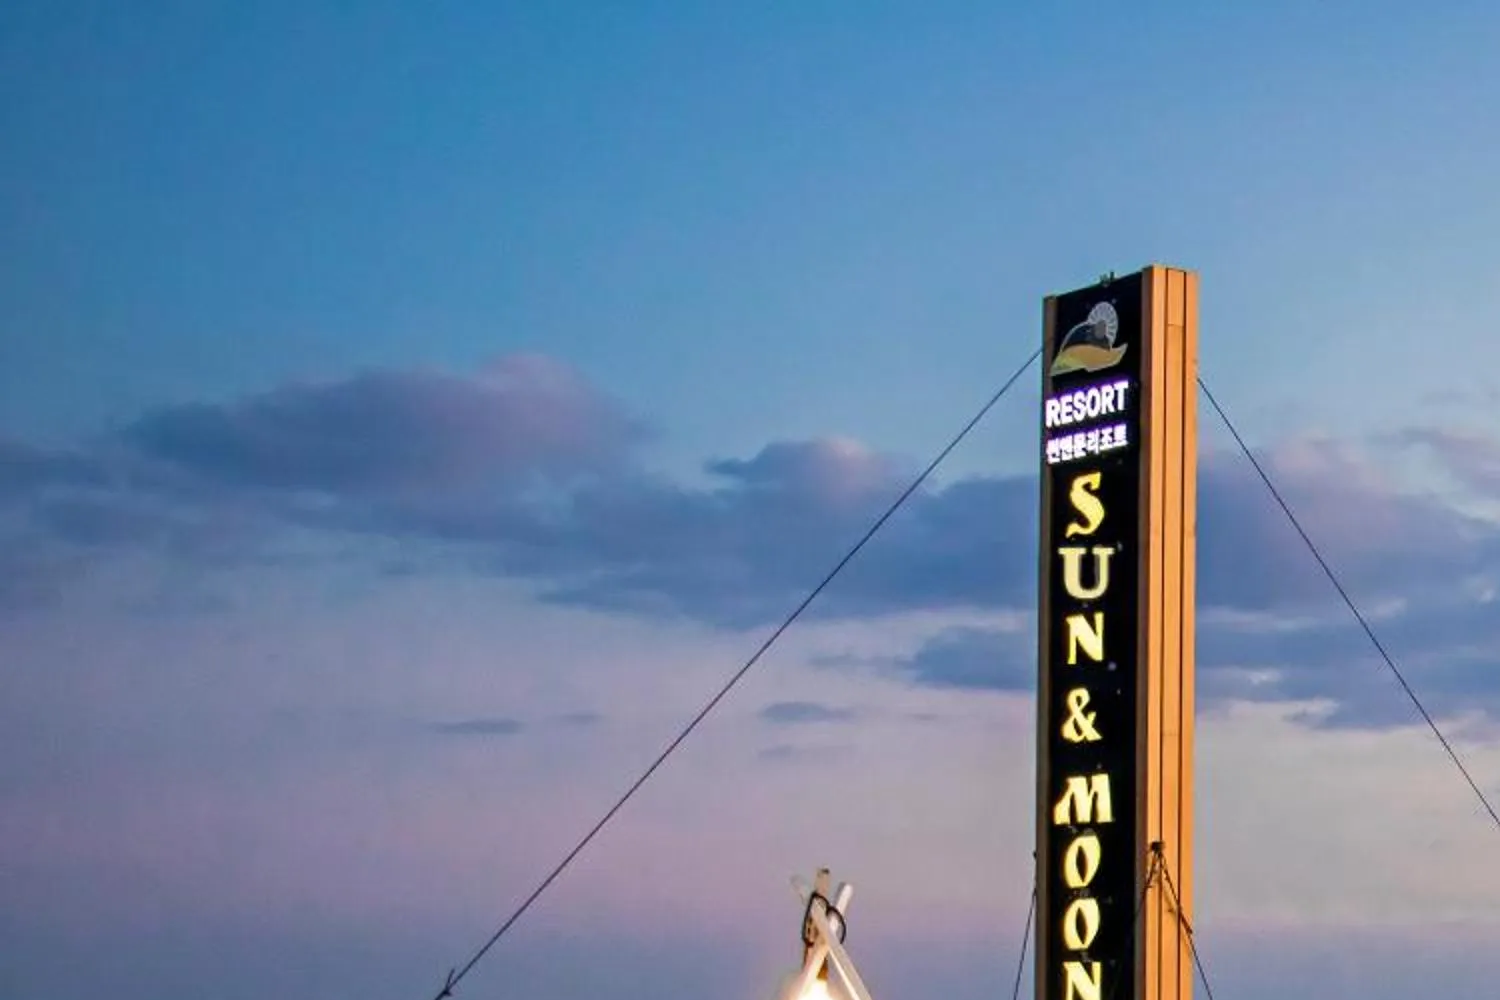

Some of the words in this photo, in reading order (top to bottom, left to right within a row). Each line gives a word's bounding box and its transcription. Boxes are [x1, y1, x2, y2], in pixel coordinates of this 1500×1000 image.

[1045, 380, 1129, 428] RESORT
[1058, 472, 1115, 665] SUN
[1061, 687, 1102, 743] &
